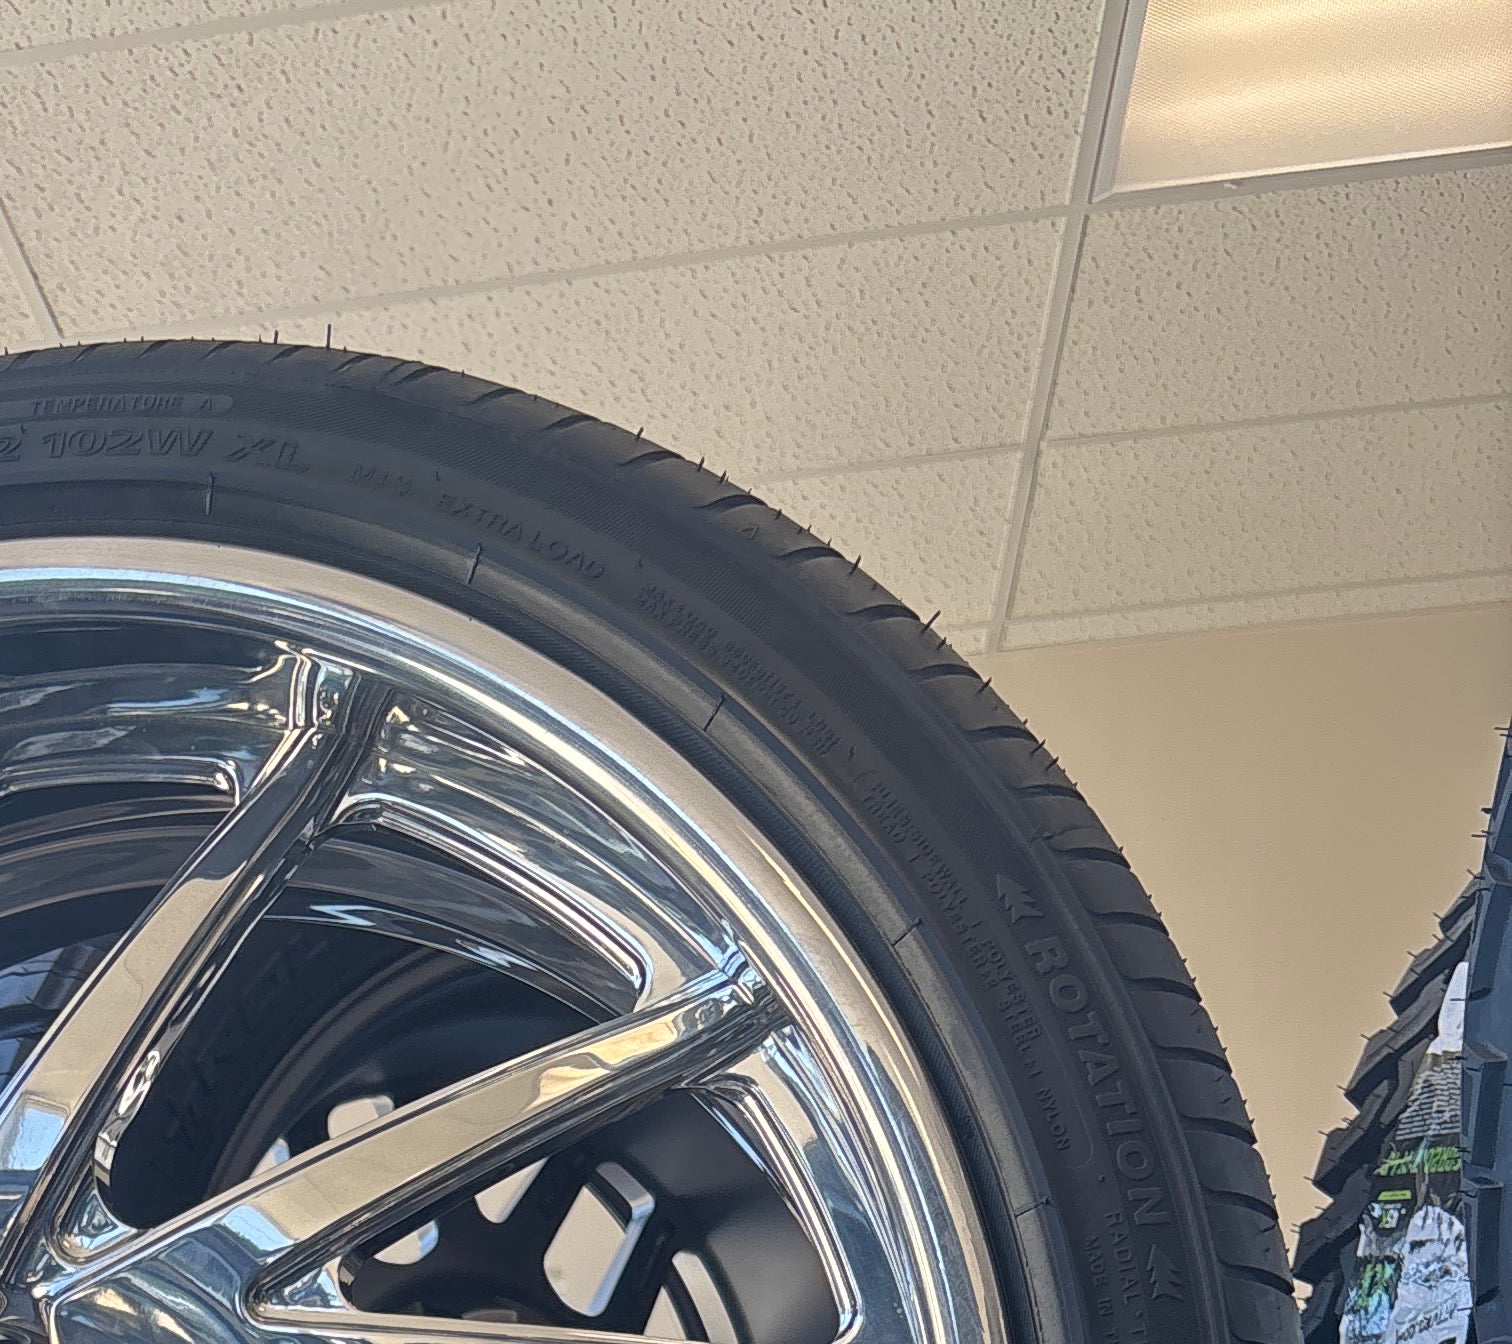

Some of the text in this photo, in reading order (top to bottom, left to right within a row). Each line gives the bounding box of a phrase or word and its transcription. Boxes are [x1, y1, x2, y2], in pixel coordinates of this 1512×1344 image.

[34, 395, 183, 417] TEMPERATURE
[42, 429, 214, 459] 102W
[228, 434, 311, 474] XL
[438, 493, 524, 542] EXTRA
[529, 531, 605, 579] LOAD
[1024, 934, 1170, 1227] ROTATION
[1038, 1087, 1072, 1151] NYLON
[1084, 1235, 1107, 1287] MADE
[1096, 1296, 1115, 1318] IN
[1104, 1208, 1143, 1308] RADIAL
